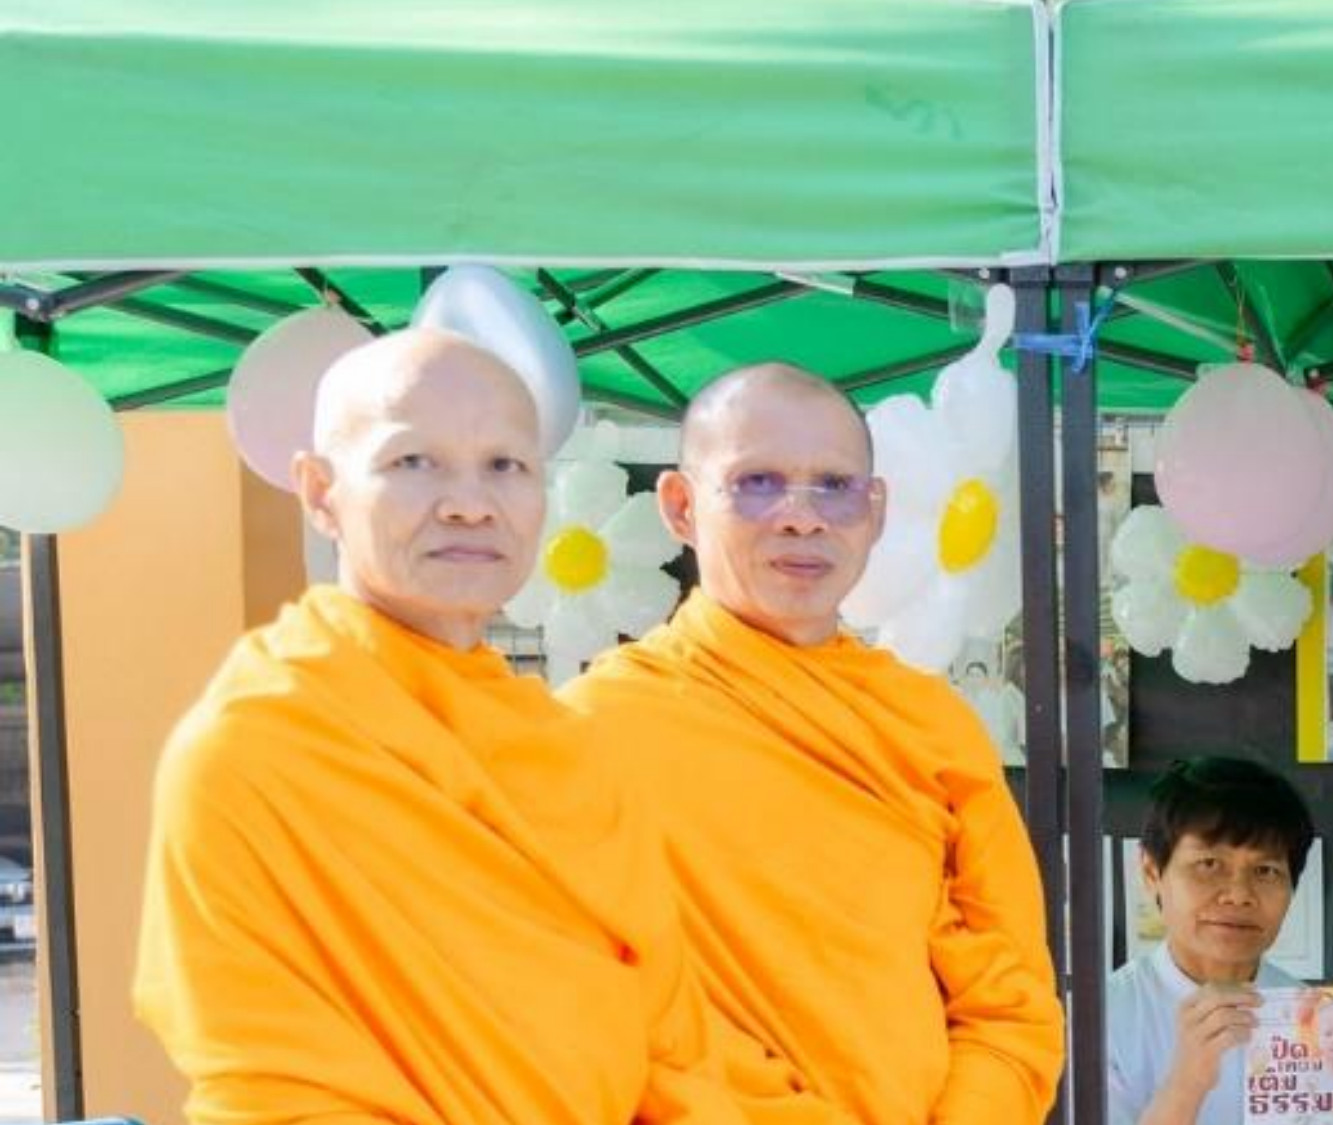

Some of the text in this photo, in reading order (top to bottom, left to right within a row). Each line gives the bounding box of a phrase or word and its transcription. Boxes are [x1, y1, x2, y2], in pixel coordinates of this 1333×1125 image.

[1270, 1035, 1309, 1060] ปิด
[1248, 1067, 1297, 1091] เต็ม
[1248, 1091, 1333, 1115] ธรรม
